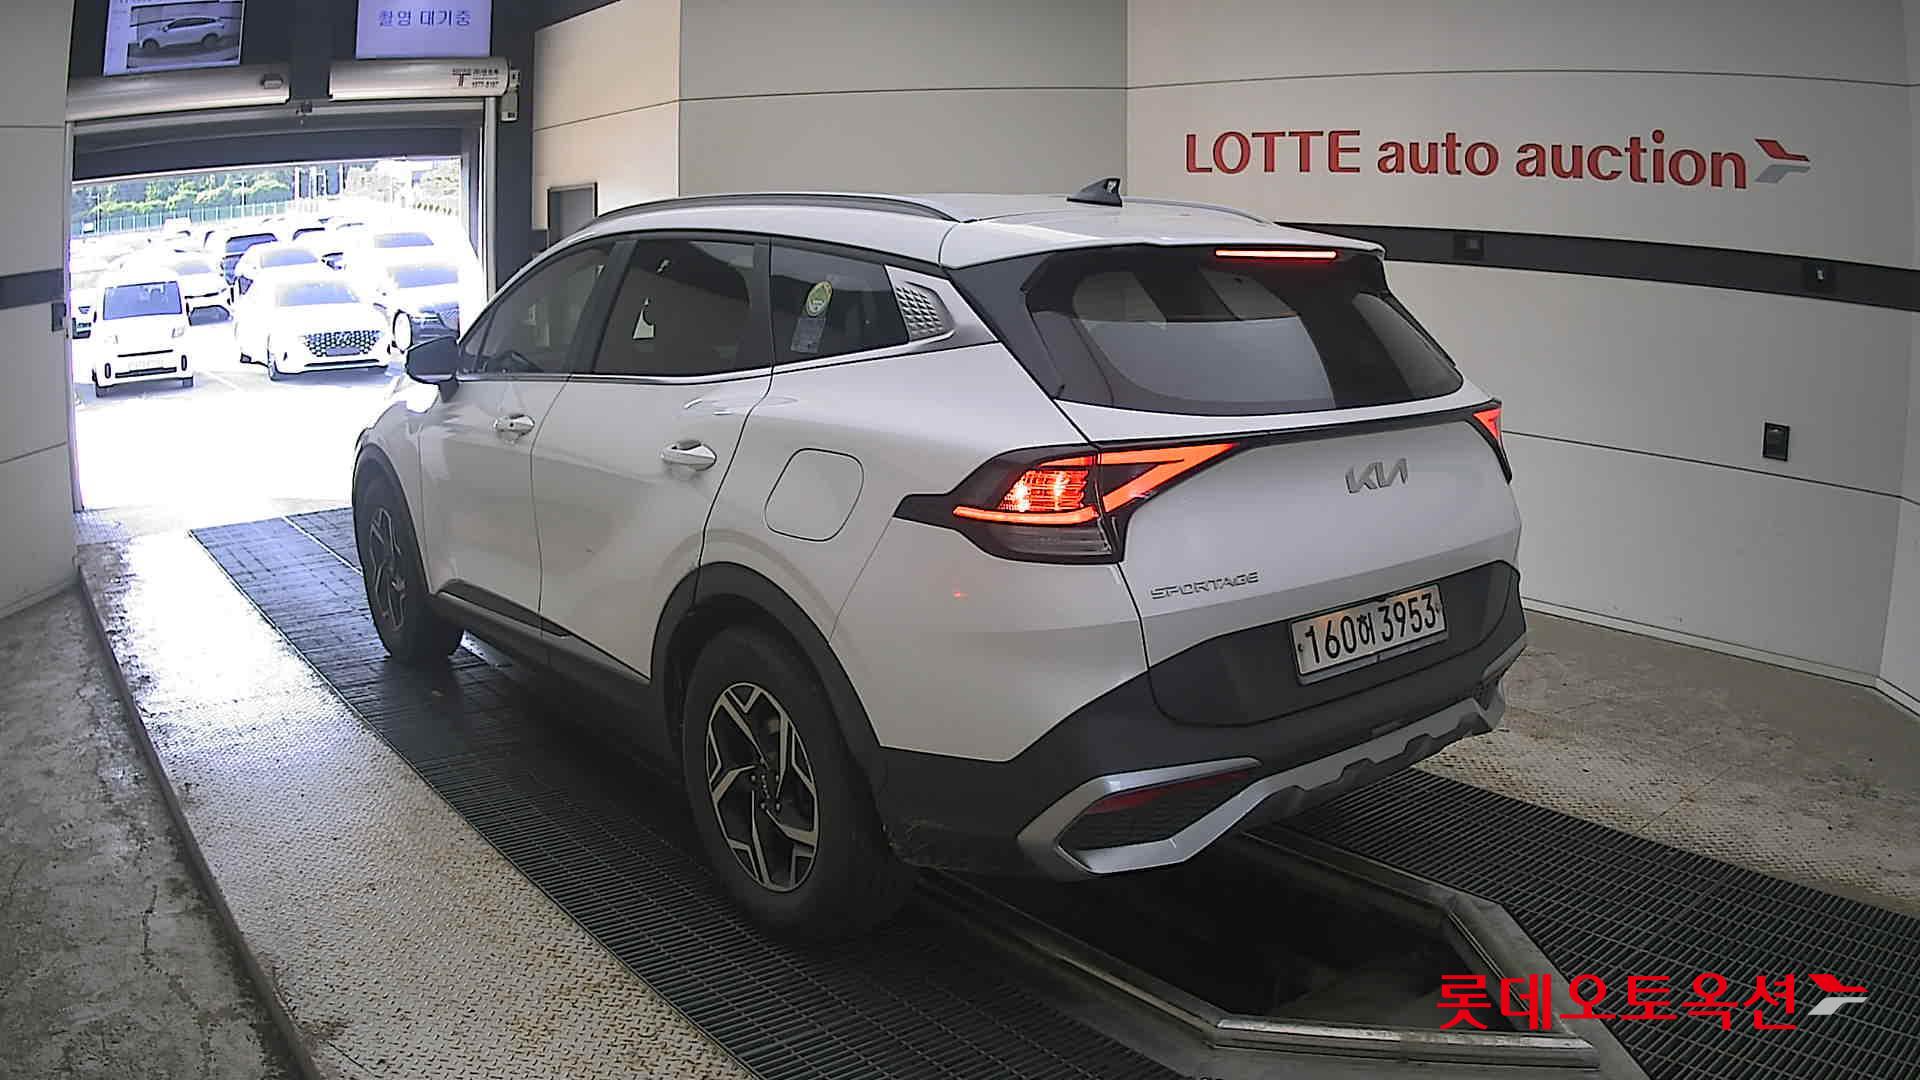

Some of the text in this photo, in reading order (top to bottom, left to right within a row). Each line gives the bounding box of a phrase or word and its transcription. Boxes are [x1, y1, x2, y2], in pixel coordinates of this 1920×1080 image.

[420, 9, 471, 27] 대기중
[1186, 130, 1747, 189] LOTTE auto auction
[1345, 457, 1409, 494] KIA
[1150, 571, 1259, 600] SPORTAGE
[1305, 592, 1436, 664] 160허 3953
